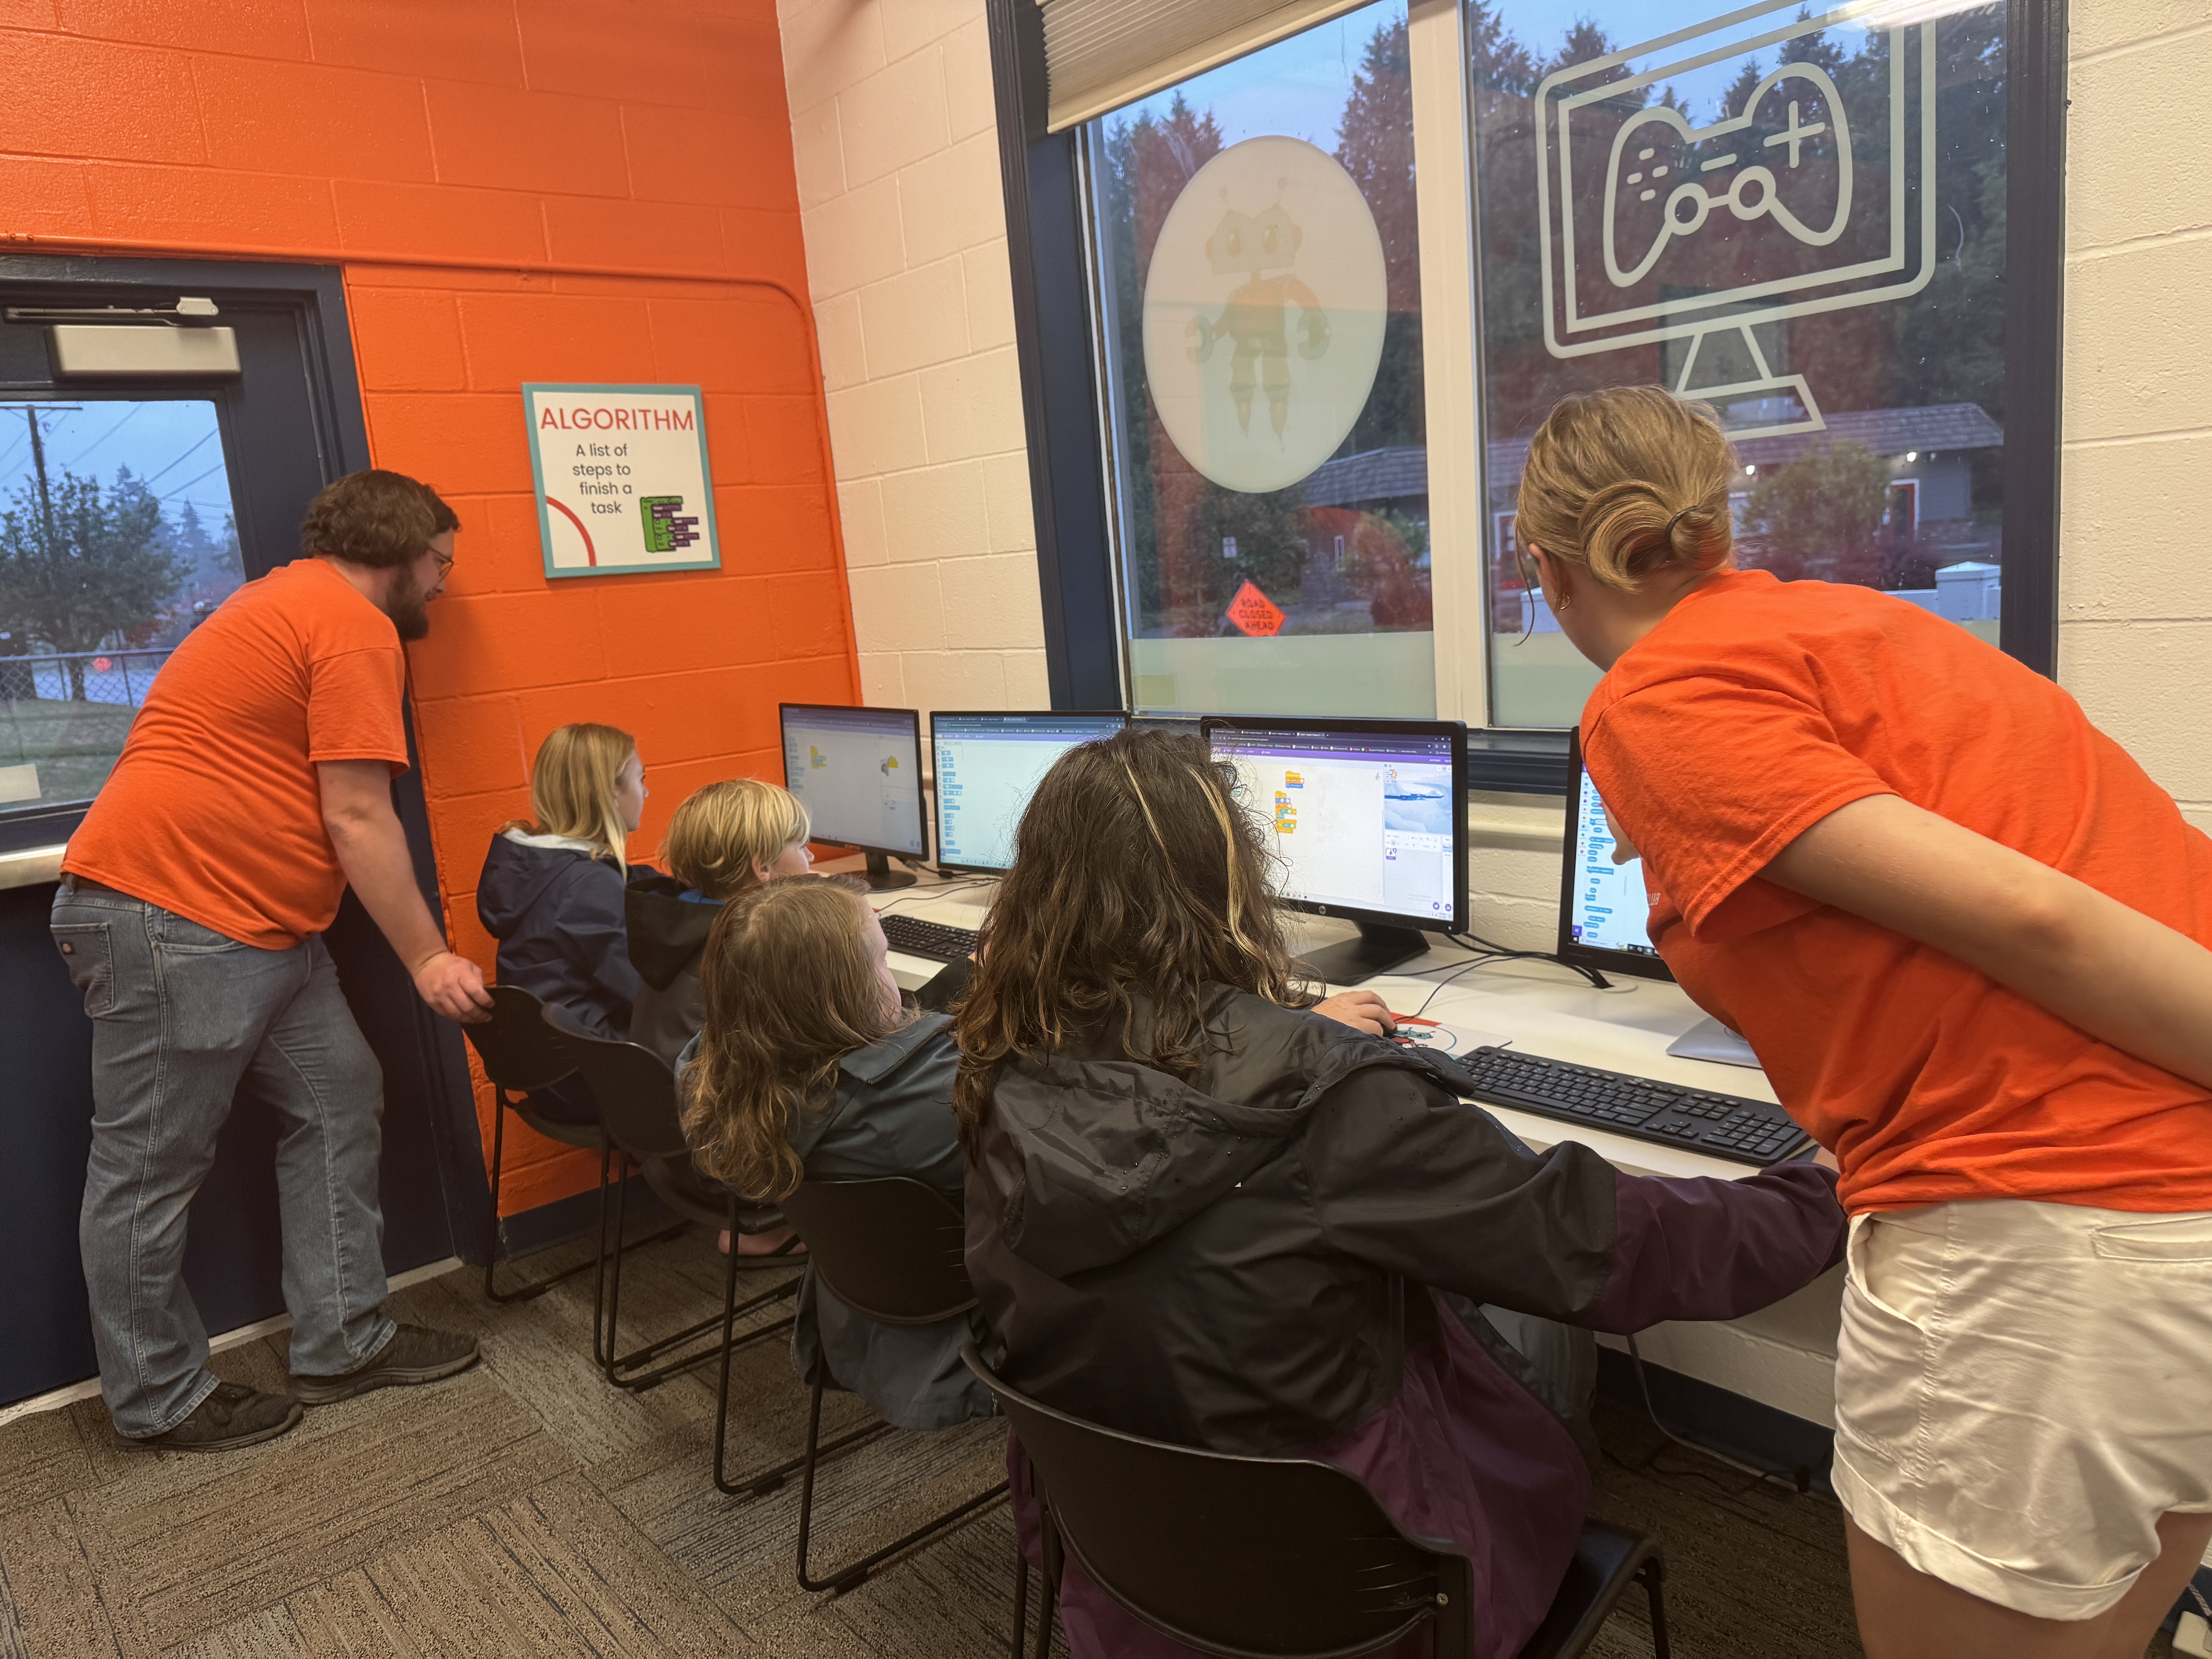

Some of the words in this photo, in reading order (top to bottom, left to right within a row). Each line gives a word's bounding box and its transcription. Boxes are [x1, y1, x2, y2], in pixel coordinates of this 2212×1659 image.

[540, 407, 694, 431] ALGORITHM
[576, 444, 585, 457] A
[590, 443, 610, 457] list
[614, 444, 628, 457] of
[572, 464, 612, 481] steps
[616, 464, 631, 476] to
[580, 482, 618, 495] finish
[623, 484, 632, 495] a
[591, 501, 622, 514] task
[1241, 599, 1265, 608] ROAD
[1239, 610, 1273, 619] CLOSED
[1245, 621, 1274, 630] AHEAD
